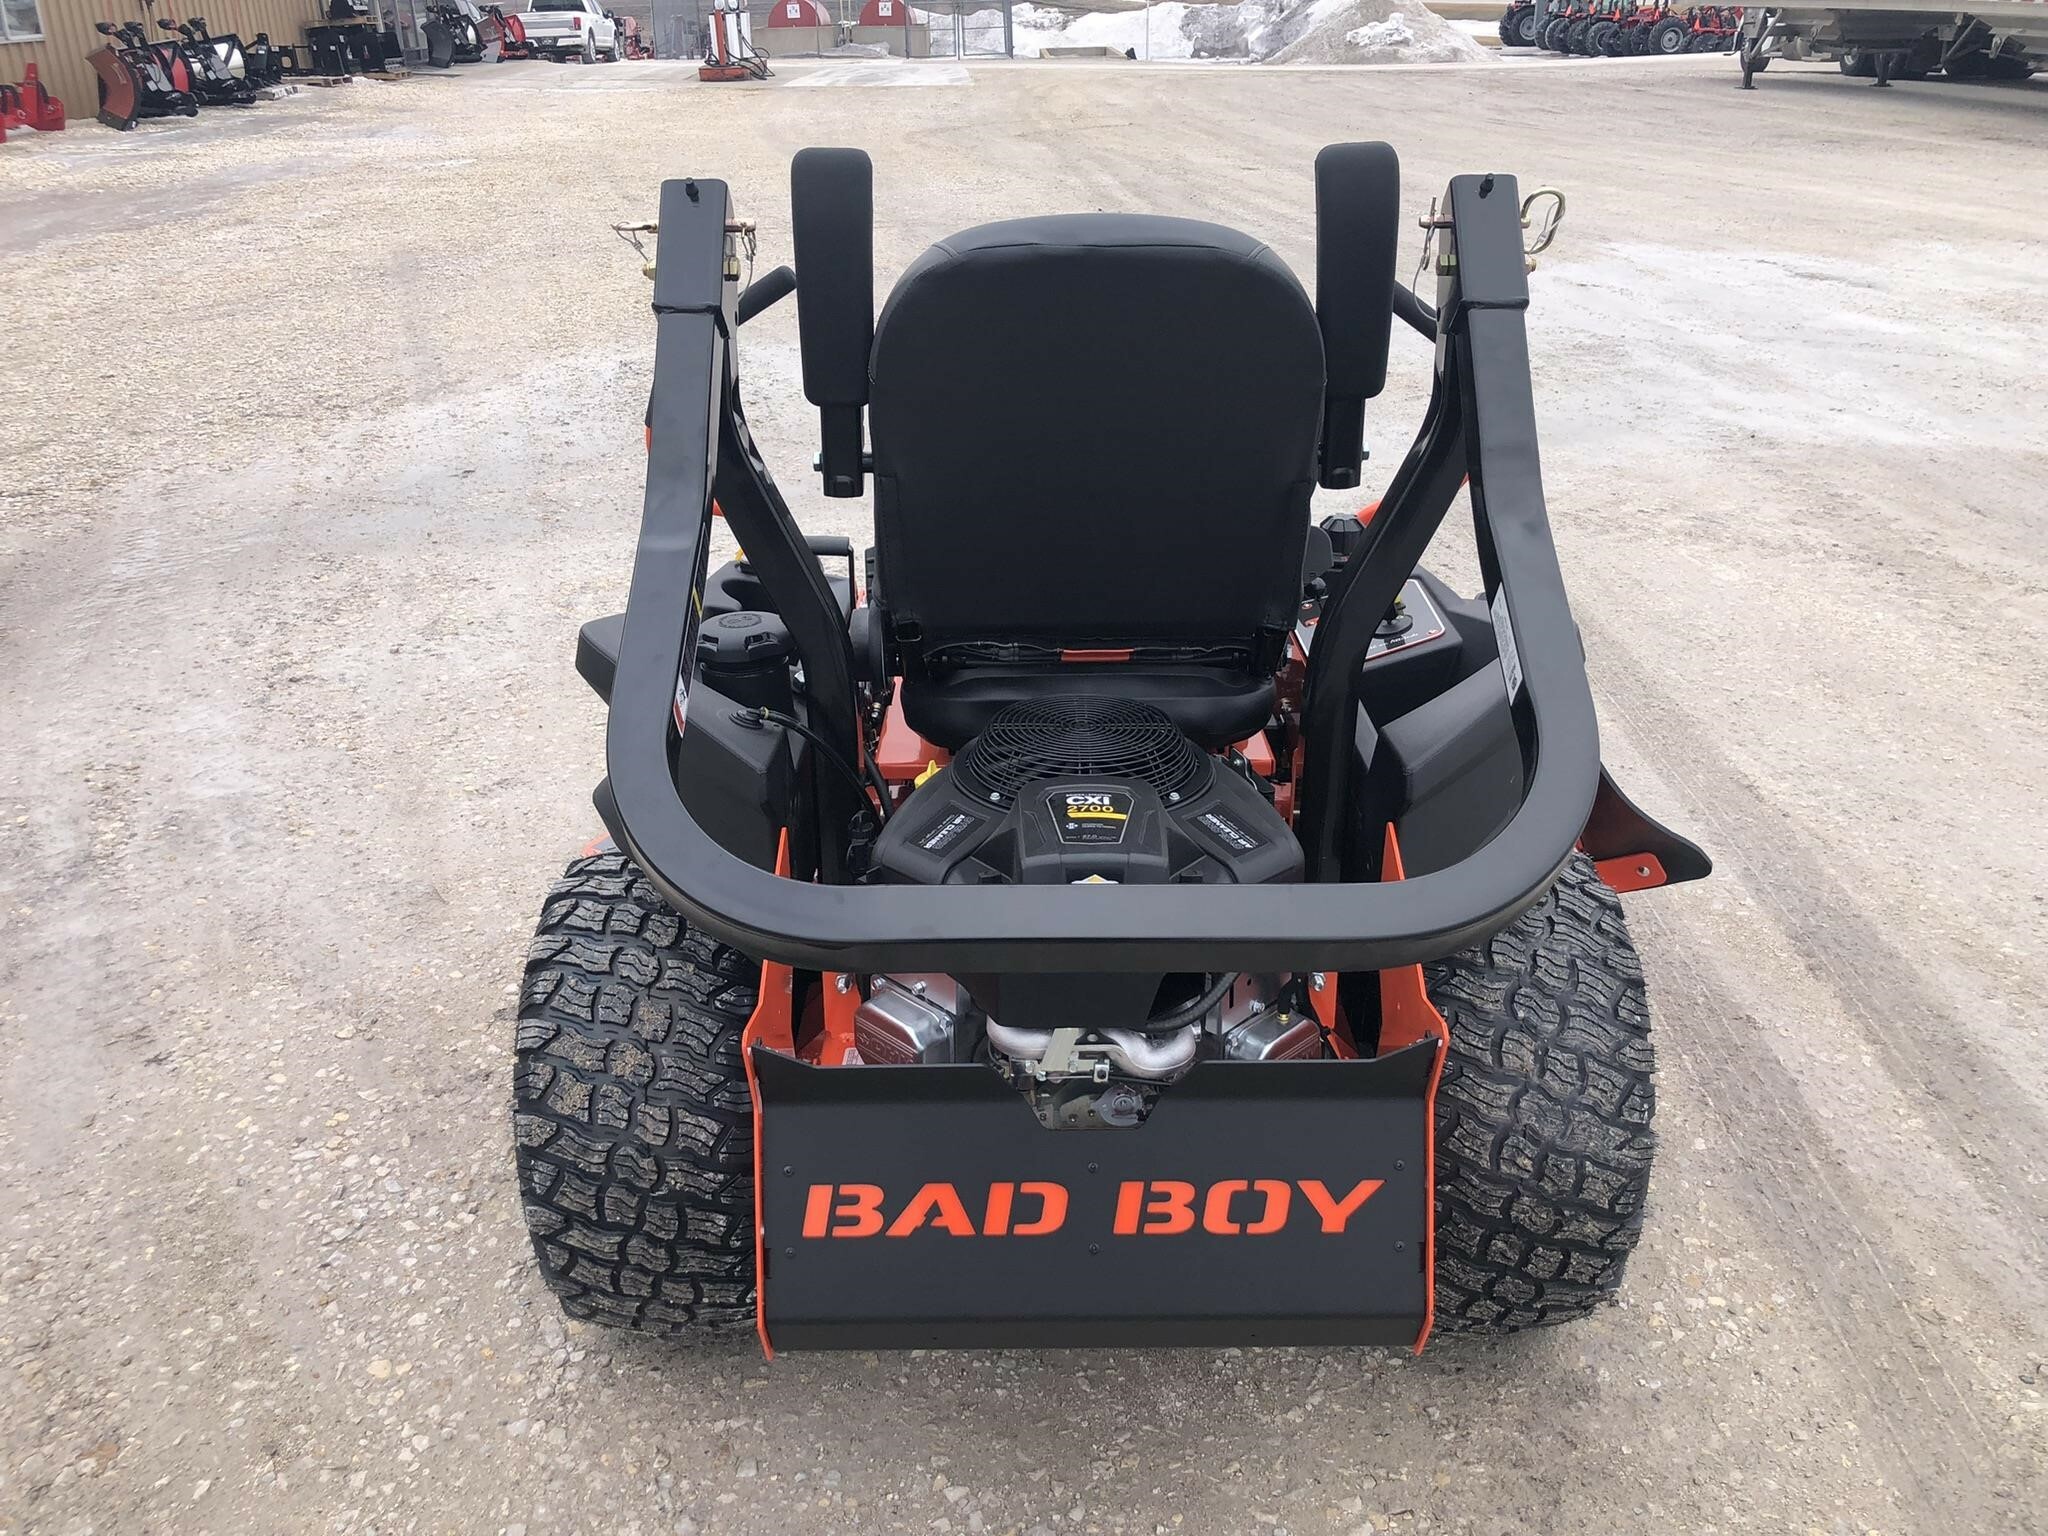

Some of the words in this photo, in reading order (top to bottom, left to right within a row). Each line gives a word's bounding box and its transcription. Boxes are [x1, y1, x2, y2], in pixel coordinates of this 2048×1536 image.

[1066, 805, 1114, 814] 2700
[802, 1181, 1070, 1239] BAD
[1113, 1179, 1388, 1236] BOY
